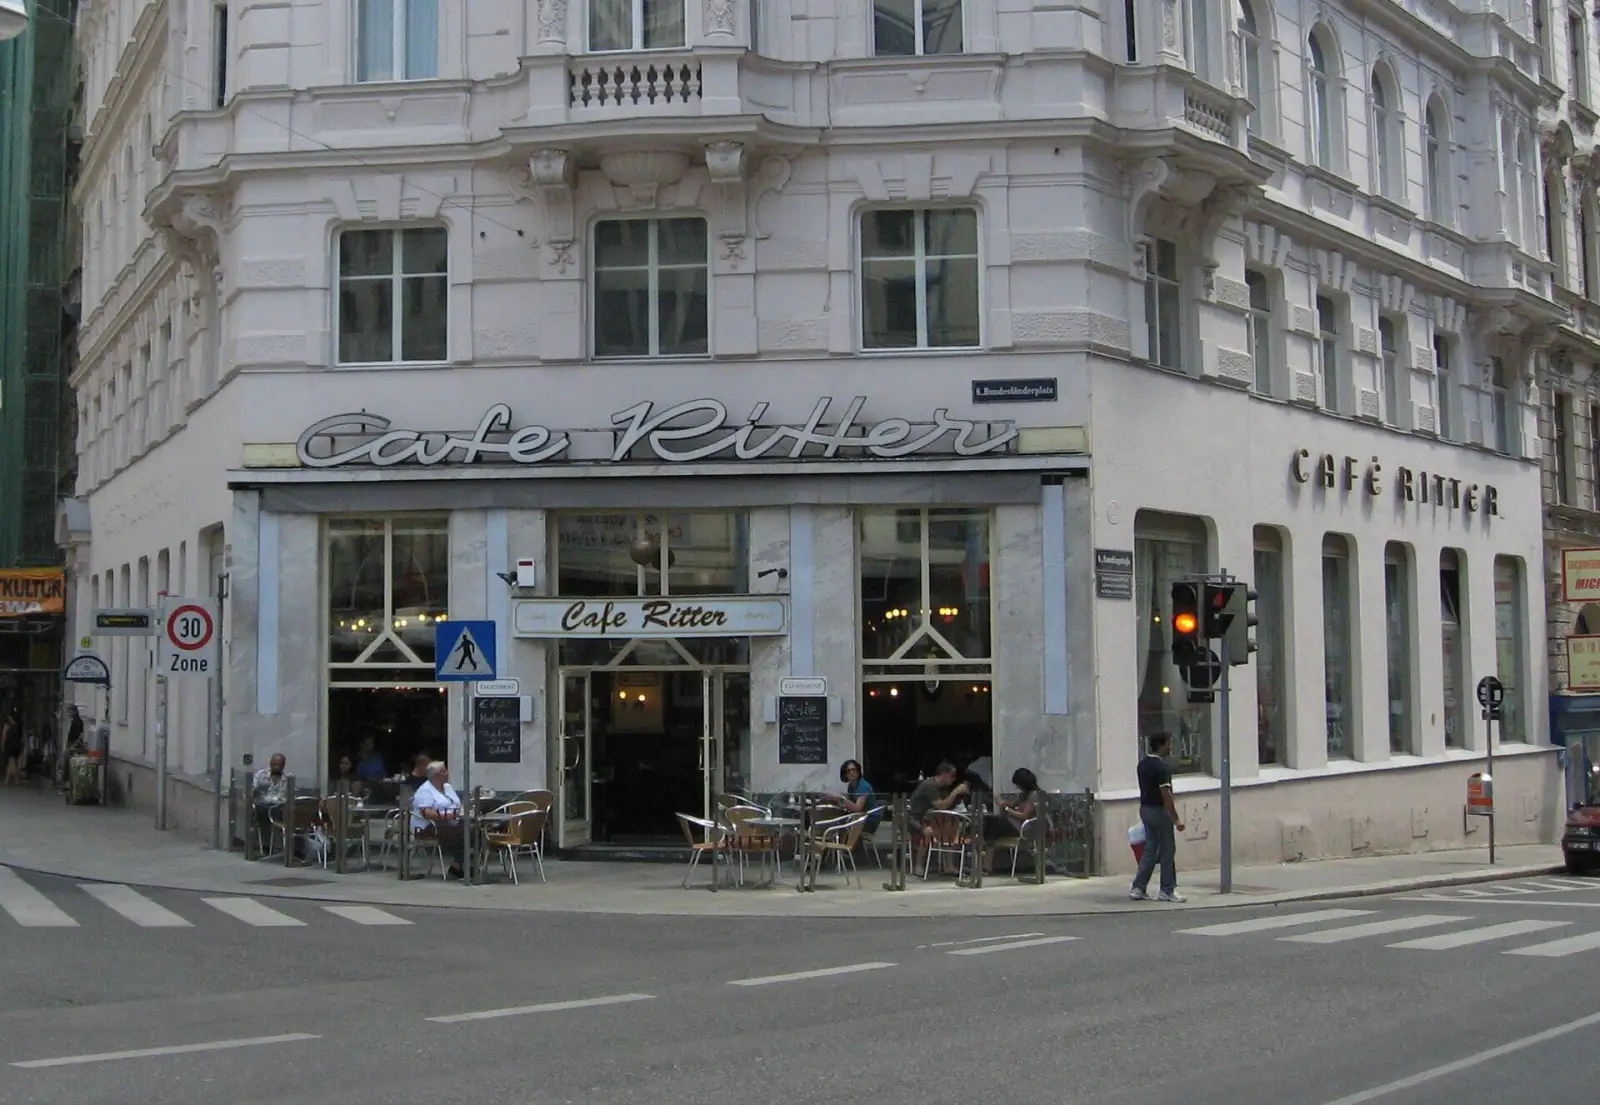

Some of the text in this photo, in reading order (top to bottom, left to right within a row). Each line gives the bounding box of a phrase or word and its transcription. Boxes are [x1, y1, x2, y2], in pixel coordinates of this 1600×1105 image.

[296, 396, 1018, 468] Cafe Ritter
[1397, 466, 1500, 516] RITTER
[180, 618, 200, 638] 30
[561, 599, 727, 634] Cafe Ritter
[170, 653, 208, 672] Zone
